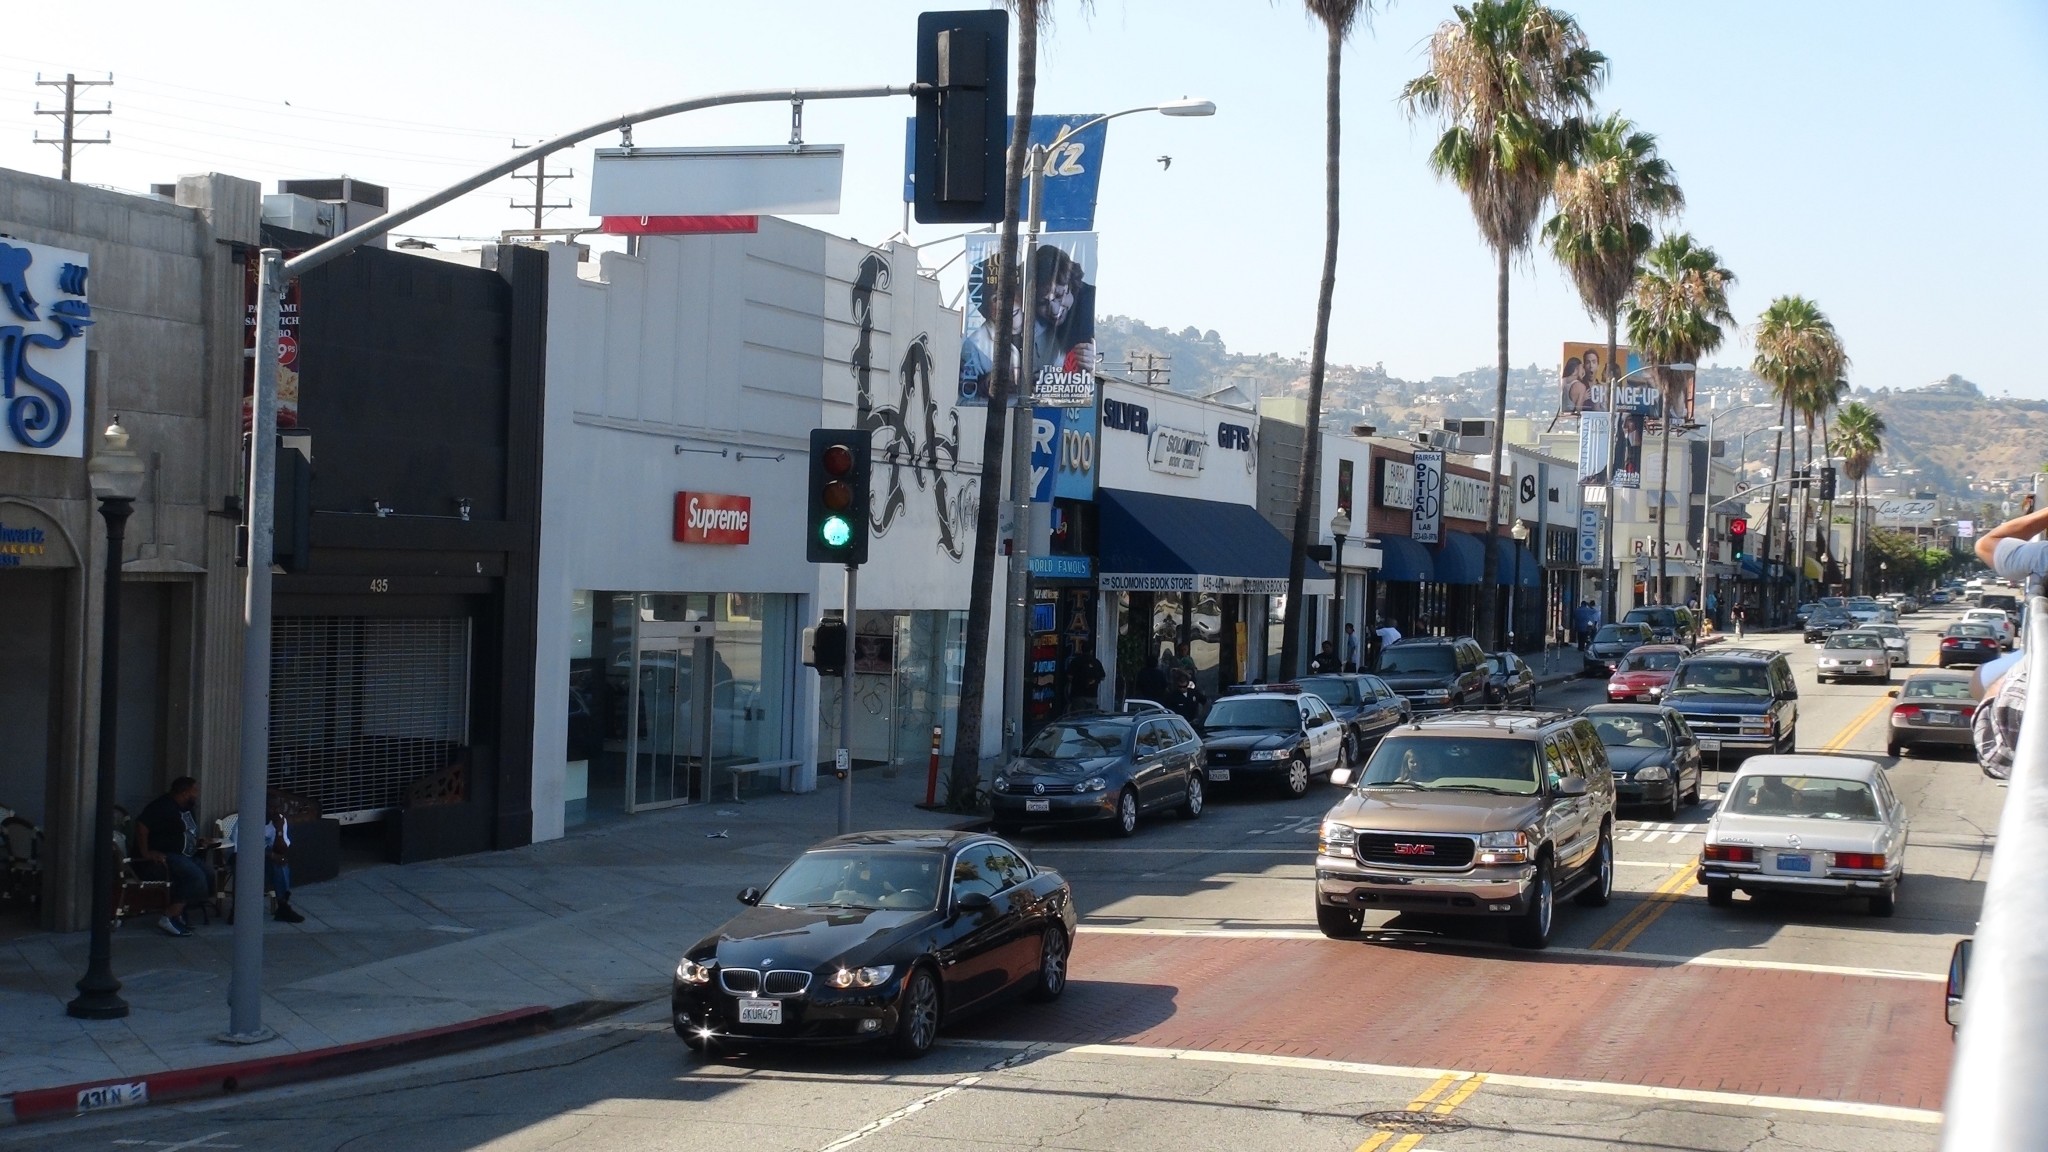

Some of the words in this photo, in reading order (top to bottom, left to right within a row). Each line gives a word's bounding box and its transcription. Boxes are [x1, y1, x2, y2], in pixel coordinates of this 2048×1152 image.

[1043, 364, 1063, 373] The
[1036, 369, 1091, 385] Jewish
[1035, 384, 1091, 393] FEDERATION
[1590, 385, 1660, 406] CHNGE-UP
[1103, 398, 1149, 436] SILVER
[1218, 422, 1250, 451] GIFTS
[1415, 454, 1441, 462] FAIRFAX
[1413, 463, 1428, 521] OPTICAL
[687, 497, 749, 539] Supreme
[1418, 523, 1432, 531] LAB
[1029, 559, 1053, 573] WORLD
[1058, 560, 1087, 574] FAMOUS
[370, 579, 388, 592] 435
[1111, 576, 1149, 589] SOLOMON'S
[1150, 577, 1169, 589] BOOK
[1170, 577, 1193, 590] STORE
[1394, 843, 1435, 856] GMC
[80, 1090, 107, 1109] 431
[111, 1088, 121, 1105] N
